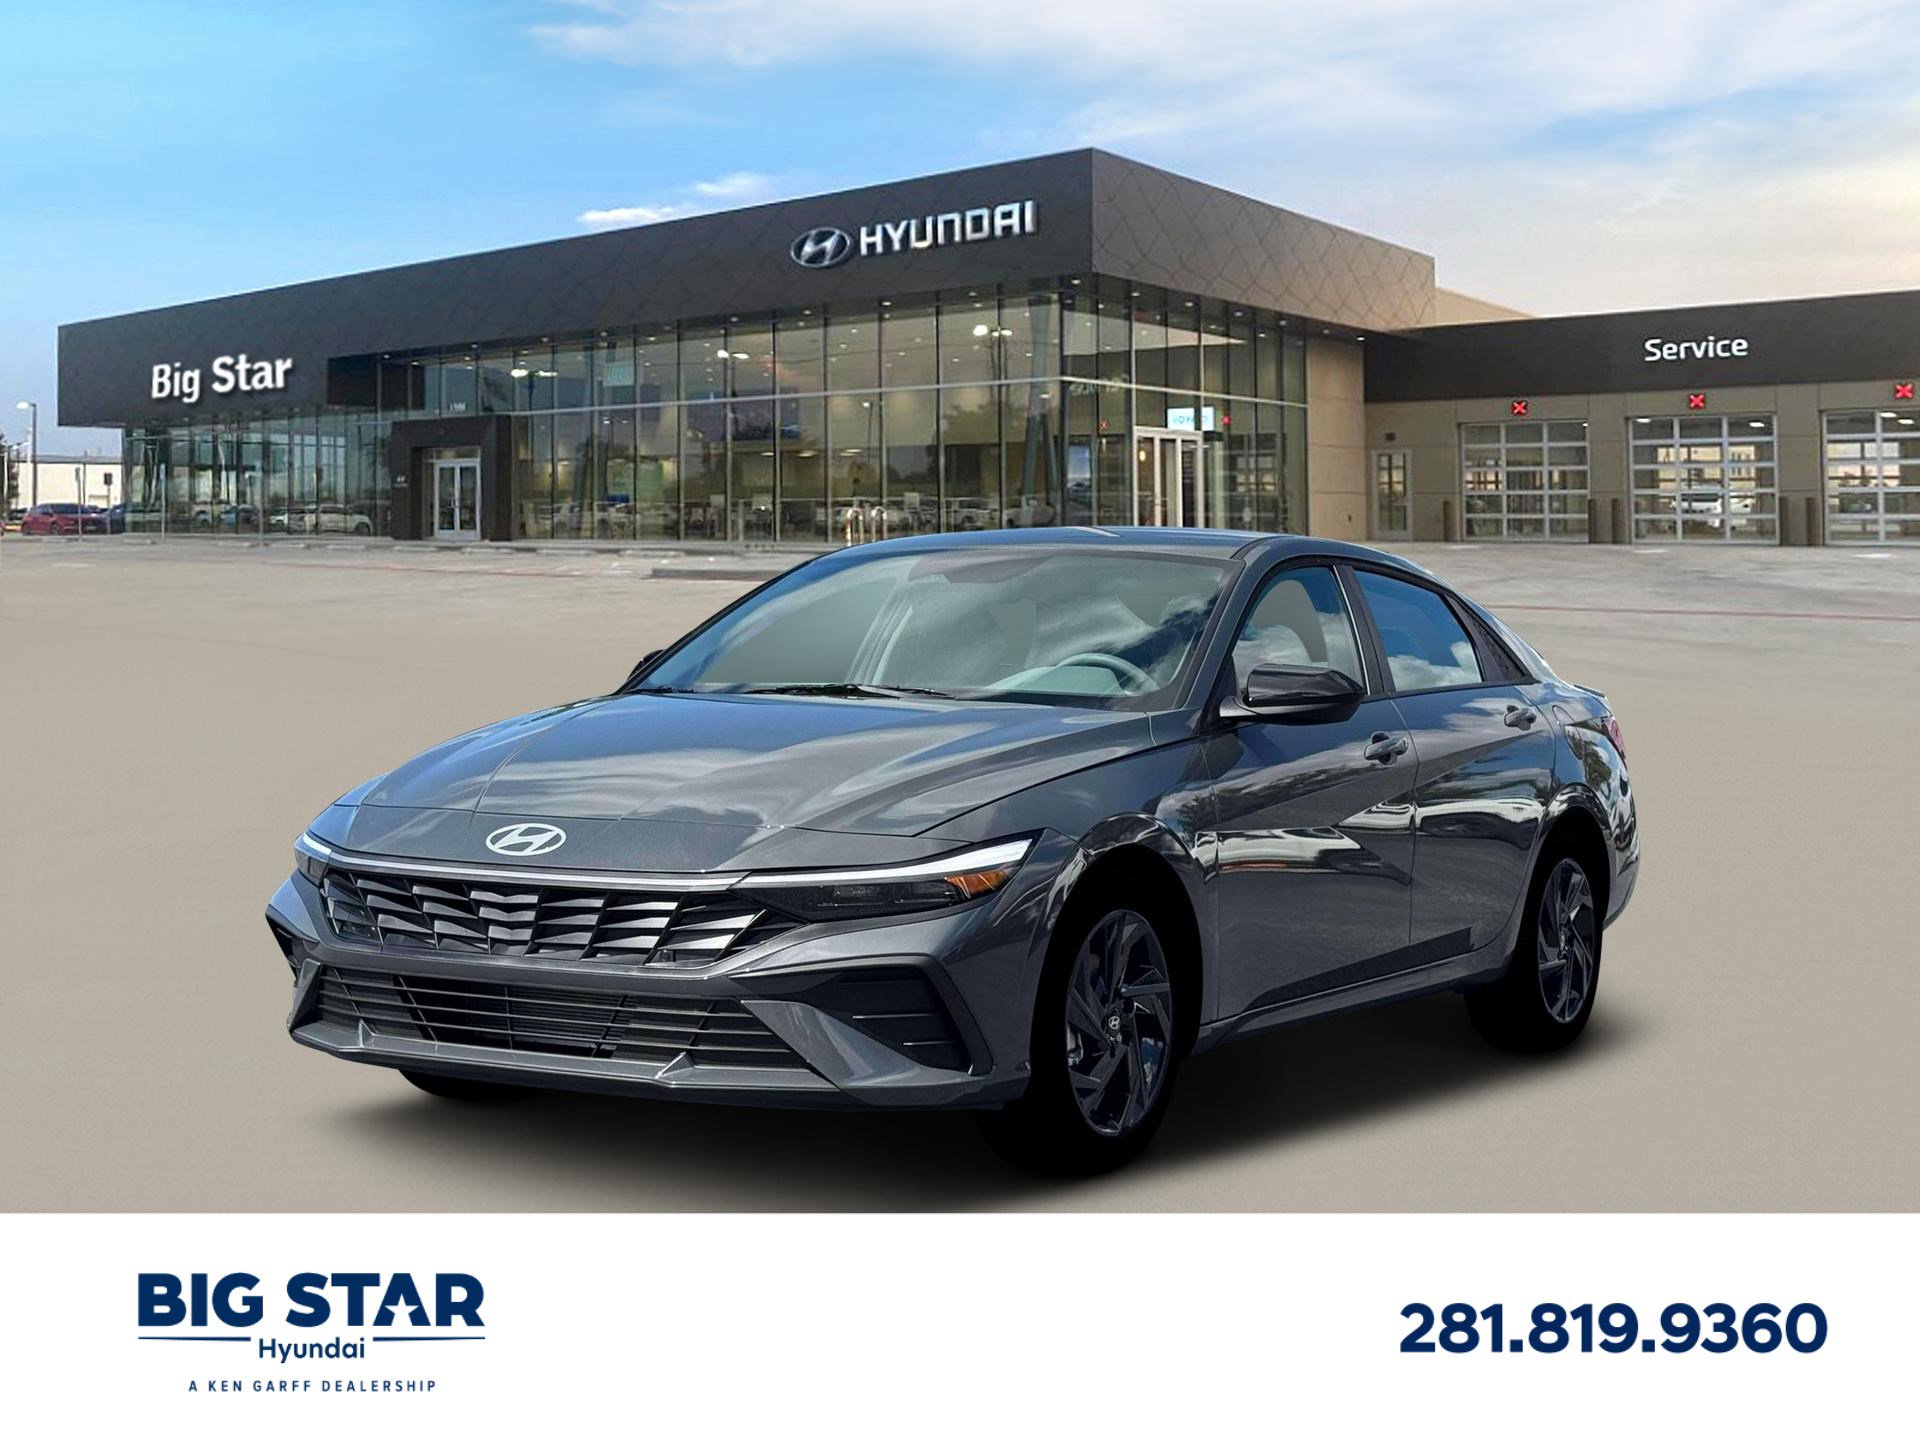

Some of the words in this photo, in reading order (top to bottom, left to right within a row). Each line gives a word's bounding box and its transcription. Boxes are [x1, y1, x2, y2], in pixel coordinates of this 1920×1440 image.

[859, 200, 1035, 257] HYUNDAI
[1644, 336, 1749, 362] Service
[151, 361, 201, 404] Big
[211, 354, 293, 393] Star
